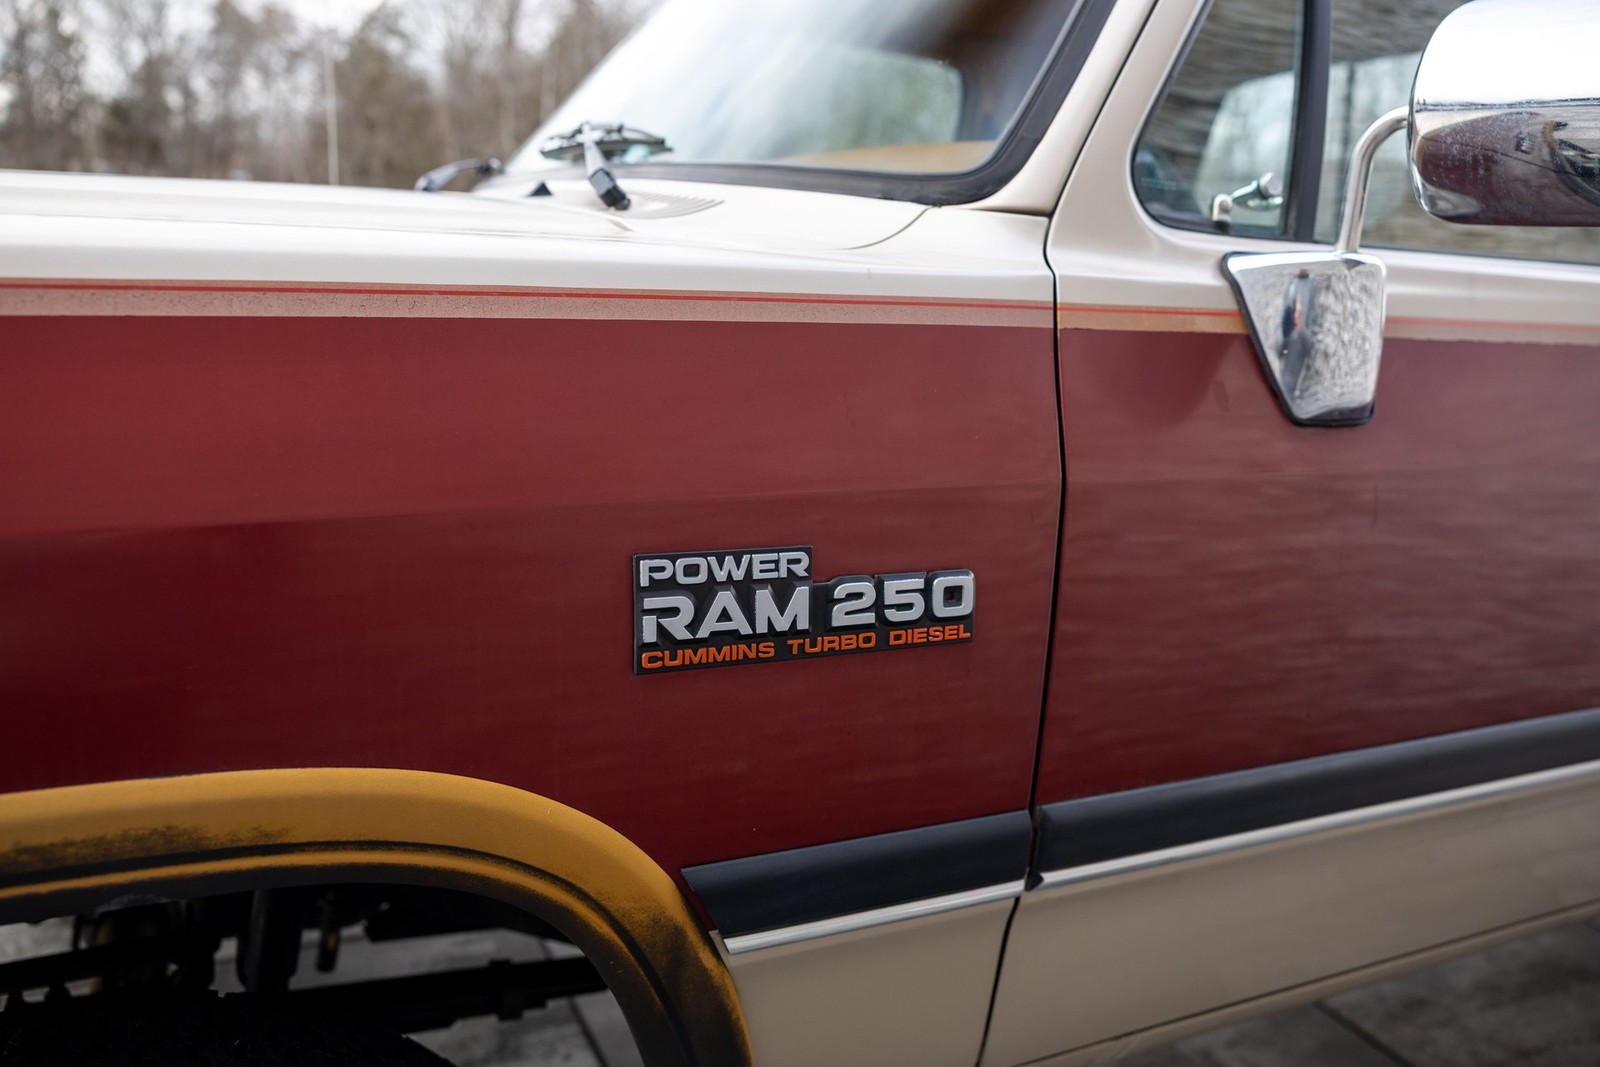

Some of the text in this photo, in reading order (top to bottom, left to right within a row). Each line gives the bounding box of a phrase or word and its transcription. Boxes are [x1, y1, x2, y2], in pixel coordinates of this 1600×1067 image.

[640, 551, 809, 587] POWER
[642, 576, 975, 643] RAM 250
[641, 624, 971, 669] CUMMINS TURBO DIESEL
